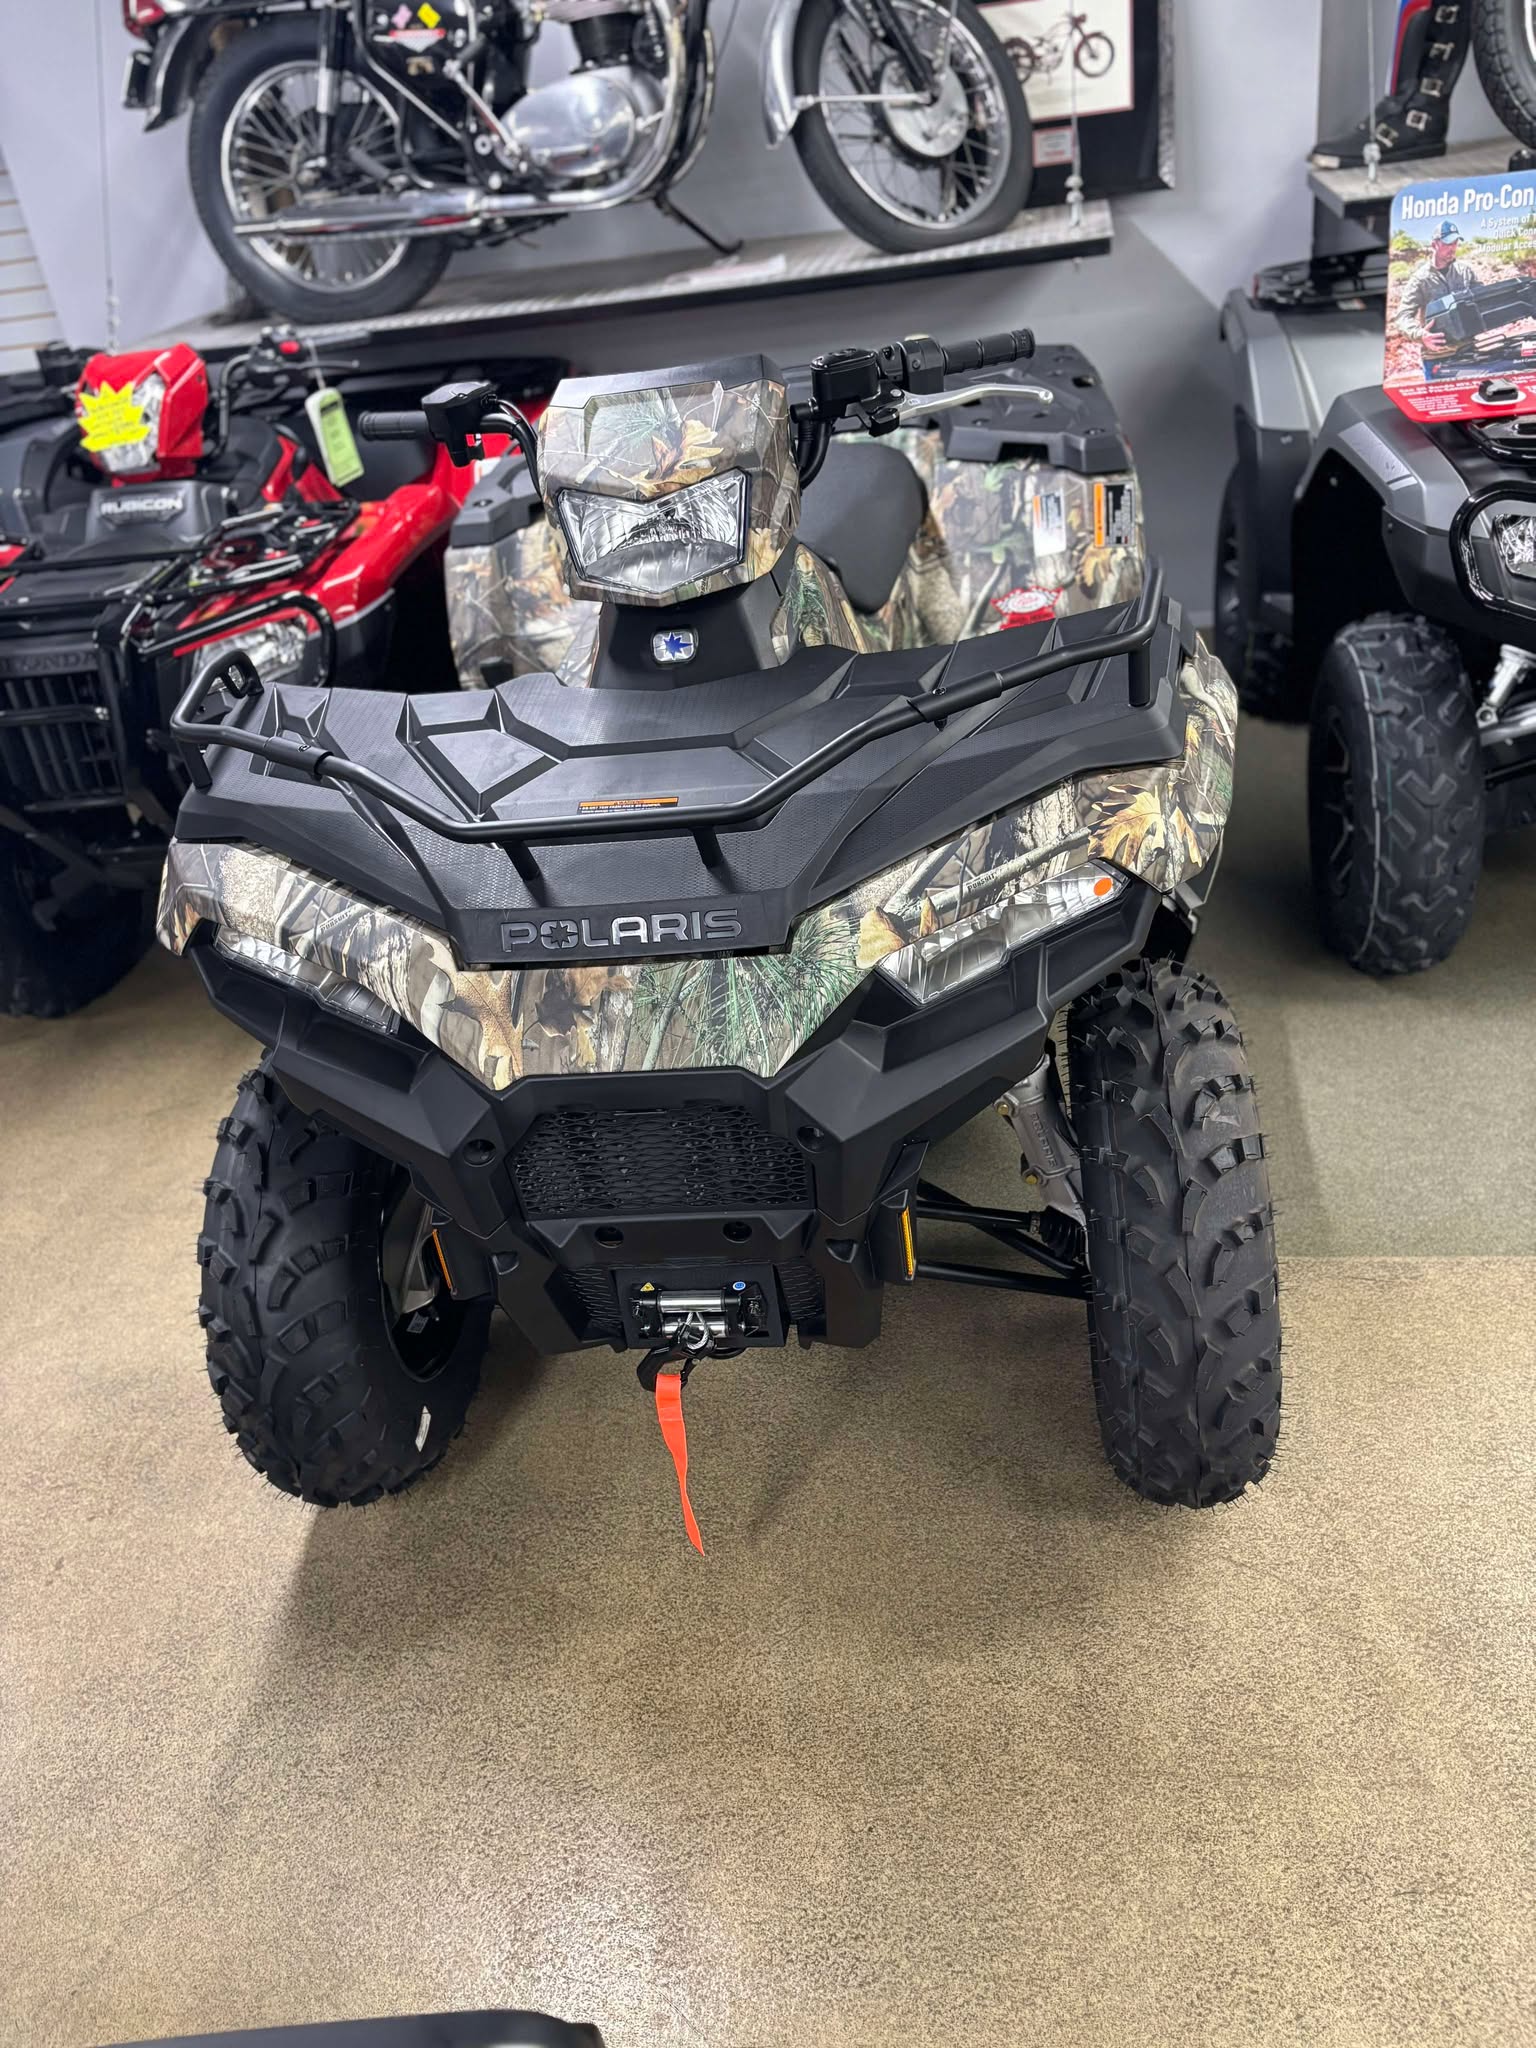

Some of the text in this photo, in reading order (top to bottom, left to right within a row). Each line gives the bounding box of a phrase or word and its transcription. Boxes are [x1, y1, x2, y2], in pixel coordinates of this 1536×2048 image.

[1402, 184, 1535, 220] Honda Pro-Con
[1480, 217, 1487, 230] A
[1488, 215, 1519, 230] System
[1521, 213, 1531, 224] of
[1494, 226, 1517, 240] Quick
[1478, 240, 1512, 253] Modular
[101, 497, 182, 515] RUBICON
[966, 872, 997, 893] PURSUIT
[501, 909, 742, 953] POLARIS
[1030, 1111, 1058, 1169] POLARIS
